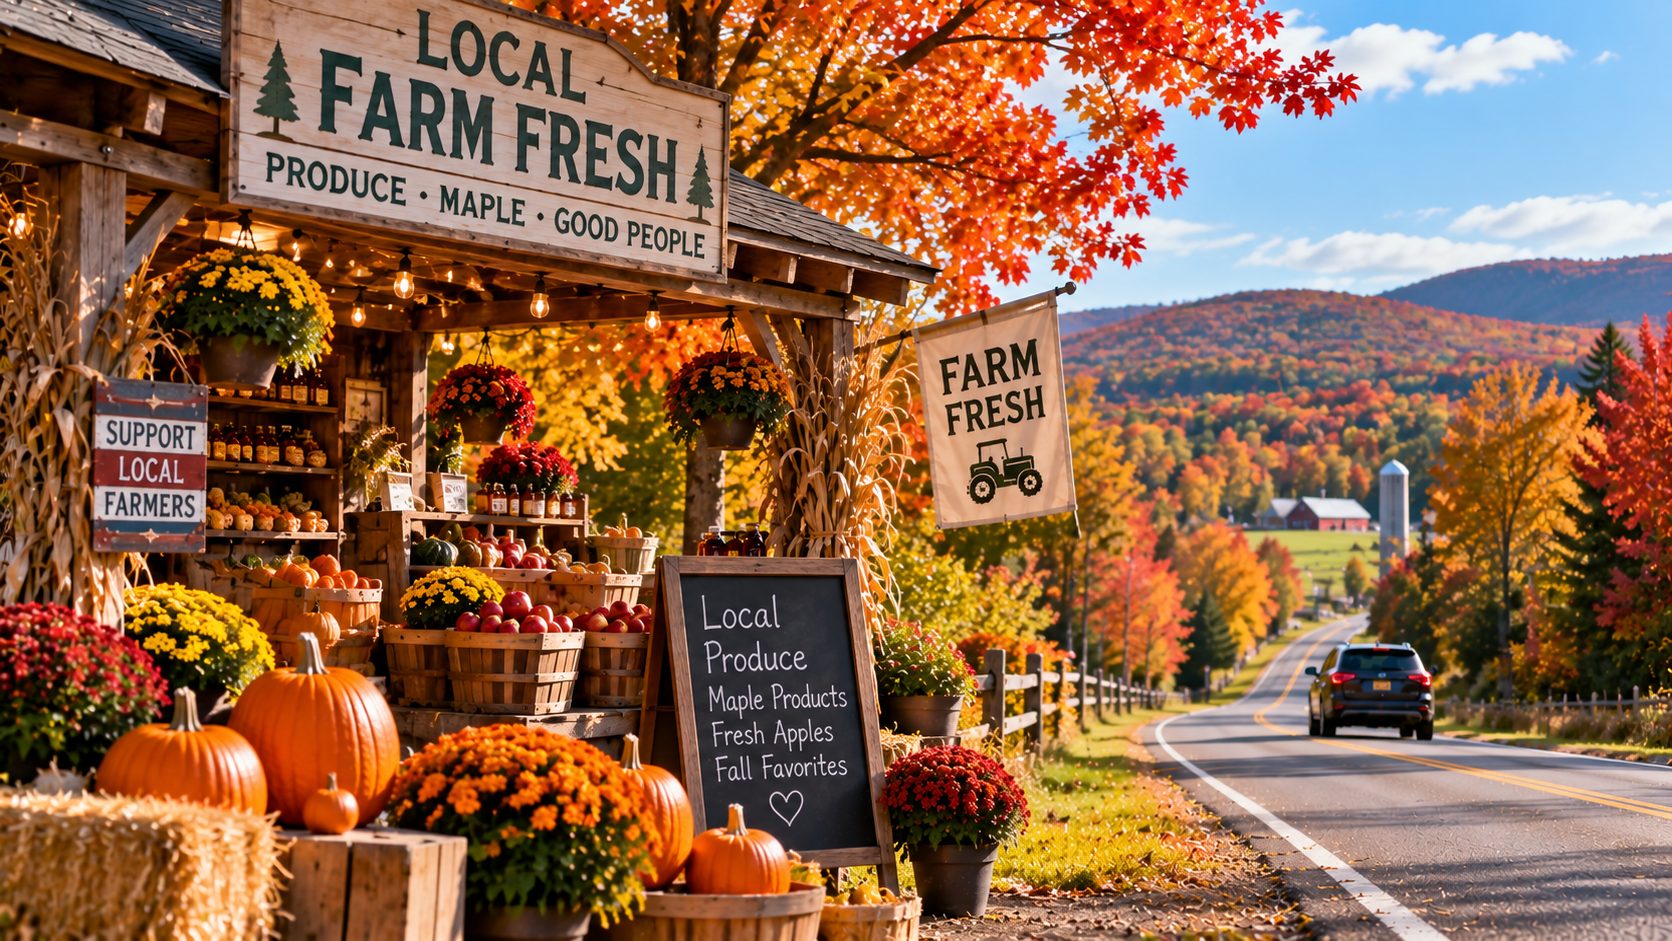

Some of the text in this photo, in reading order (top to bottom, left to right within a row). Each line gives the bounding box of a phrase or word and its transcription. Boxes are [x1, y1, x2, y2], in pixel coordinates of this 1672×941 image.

[416, 8, 587, 104] LOCAL
[319, 48, 678, 204] FARM FRESH
[265, 151, 705, 260] PRODUCE MAPLE GOOD PEOPLE
[939, 338, 1042, 396] FARM
[945, 385, 1046, 436] FRESH
[106, 419, 196, 450] SUPPORT
[118, 455, 184, 484] LOCAL
[104, 491, 196, 518] FARMERS
[701, 594, 781, 631] Local
[703, 640, 808, 674] Produce
[708, 683, 848, 719] Maple Products
[711, 718, 834, 752] Fresh Apples
[715, 753, 848, 782] Fall Favorites
